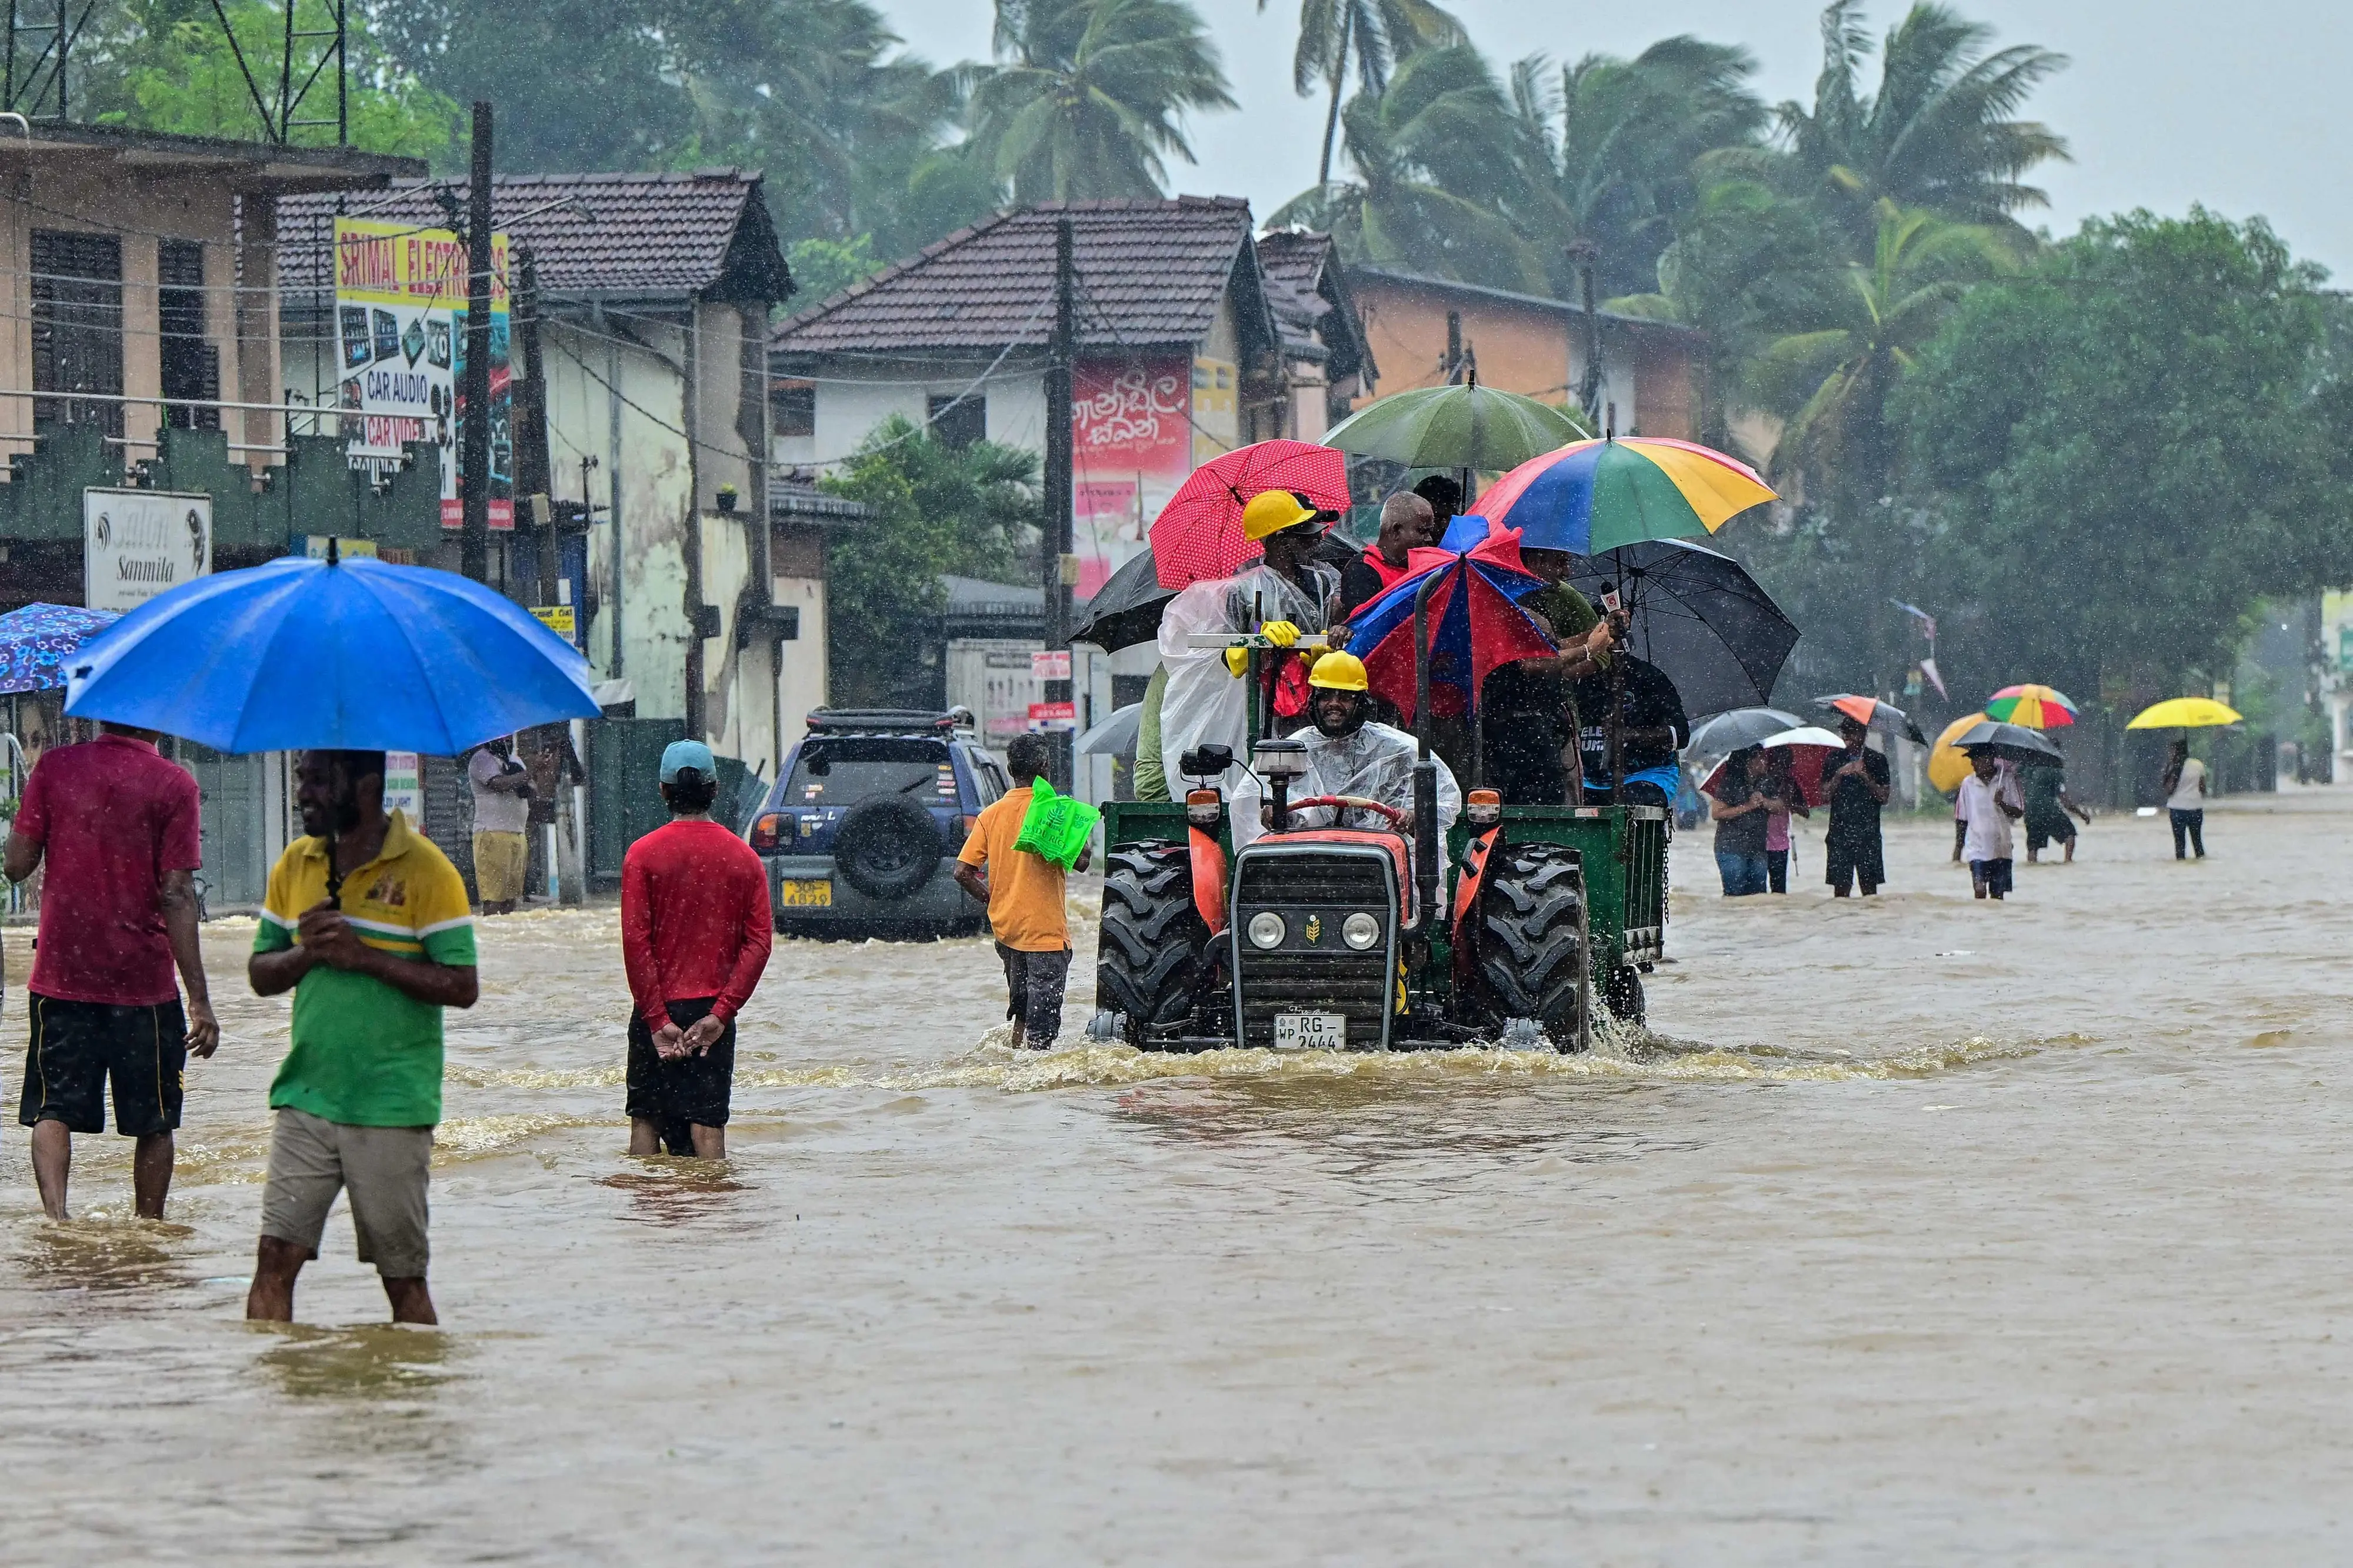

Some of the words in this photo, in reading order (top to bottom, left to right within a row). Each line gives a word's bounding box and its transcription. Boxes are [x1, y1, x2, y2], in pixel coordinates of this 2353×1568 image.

[341, 231, 399, 291] SRIMAL
[368, 371, 390, 401] CAR
[393, 373, 427, 404] AUDIO
[368, 415, 391, 447] CAR
[1279, 1028, 1295, 1040] WP
